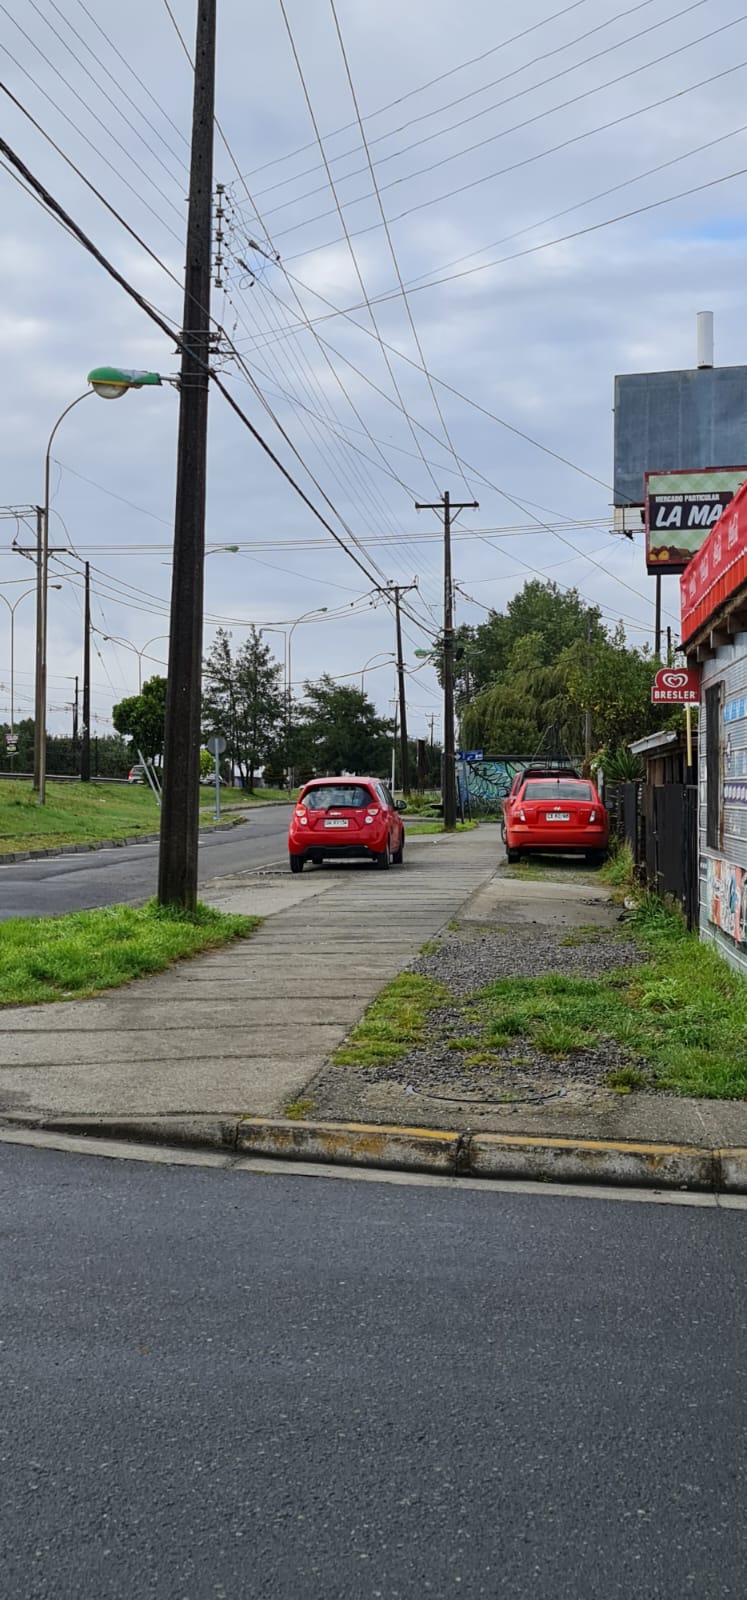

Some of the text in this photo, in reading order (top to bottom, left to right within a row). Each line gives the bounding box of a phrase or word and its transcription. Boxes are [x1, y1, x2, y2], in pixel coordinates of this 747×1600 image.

[655, 493, 720, 503] MERCADO PARTICULAR
[655, 503, 727, 527] LA MA
[654, 690, 696, 699] BRESLER
